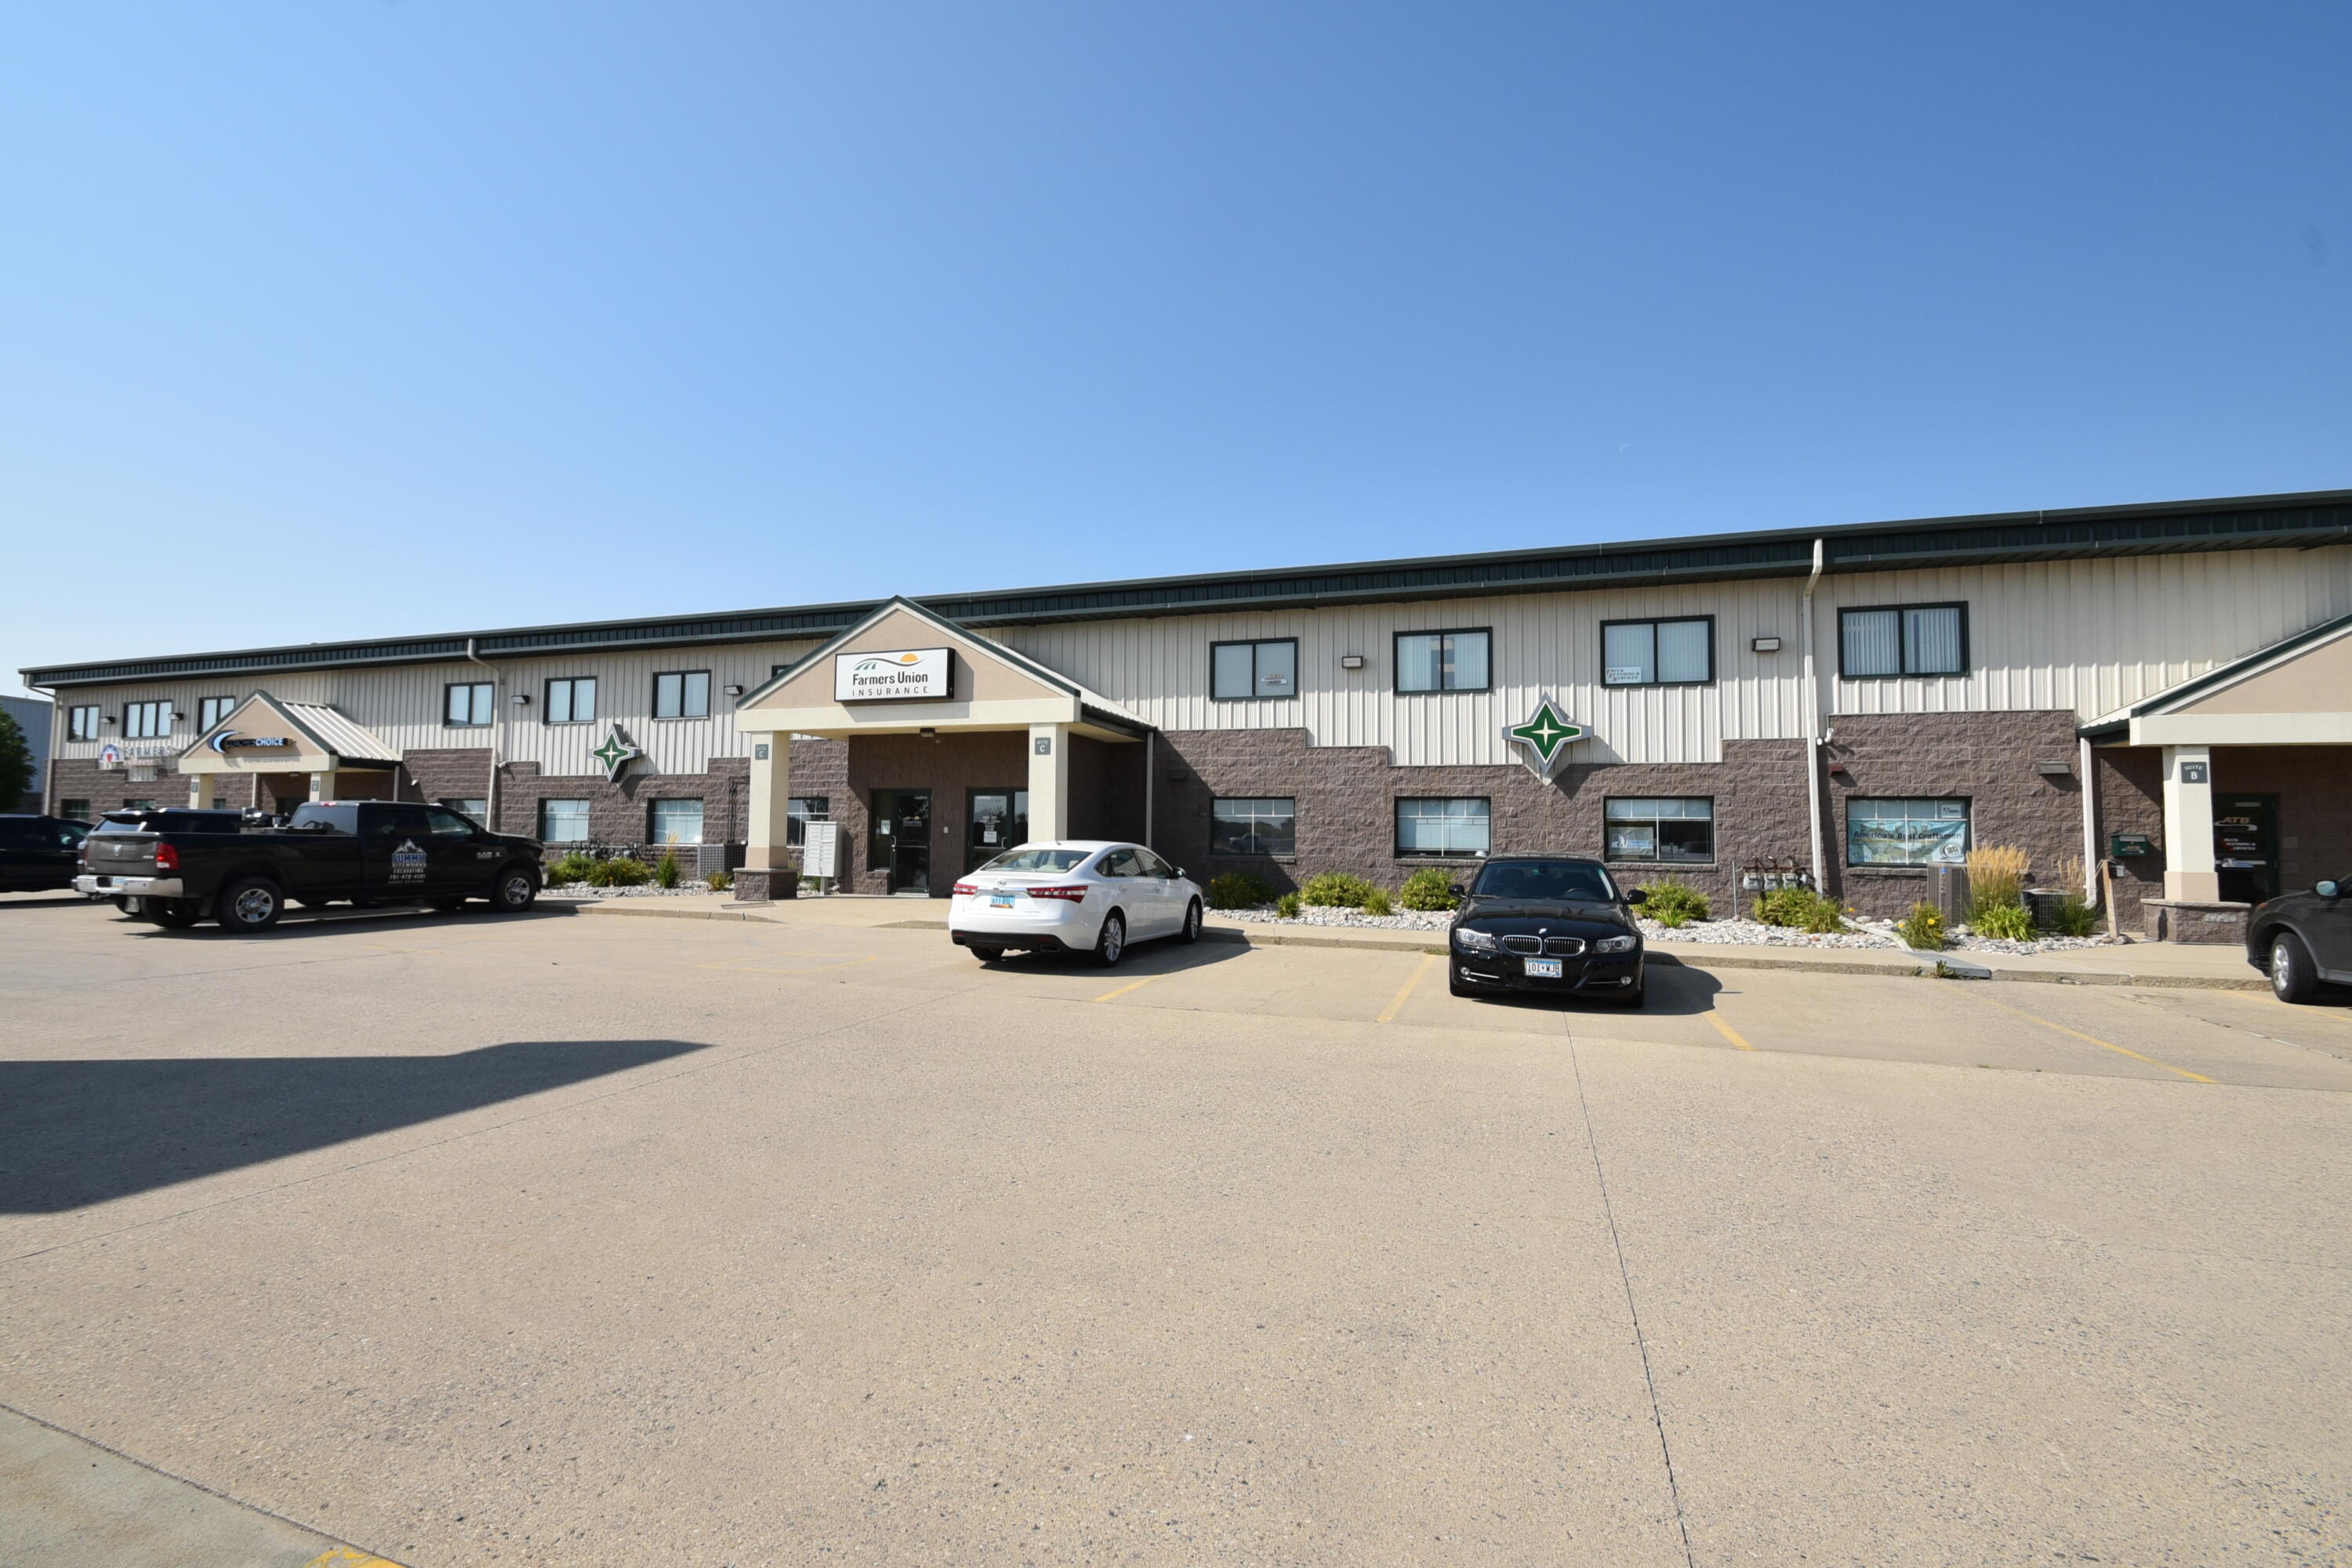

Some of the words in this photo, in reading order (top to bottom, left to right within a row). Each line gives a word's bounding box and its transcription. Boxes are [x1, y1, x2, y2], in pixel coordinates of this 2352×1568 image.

[853, 673, 895, 686] Farmers
[898, 671, 928, 684] Union
[852, 686, 928, 696] INSURANCE
[2190, 771, 2198, 780] B
